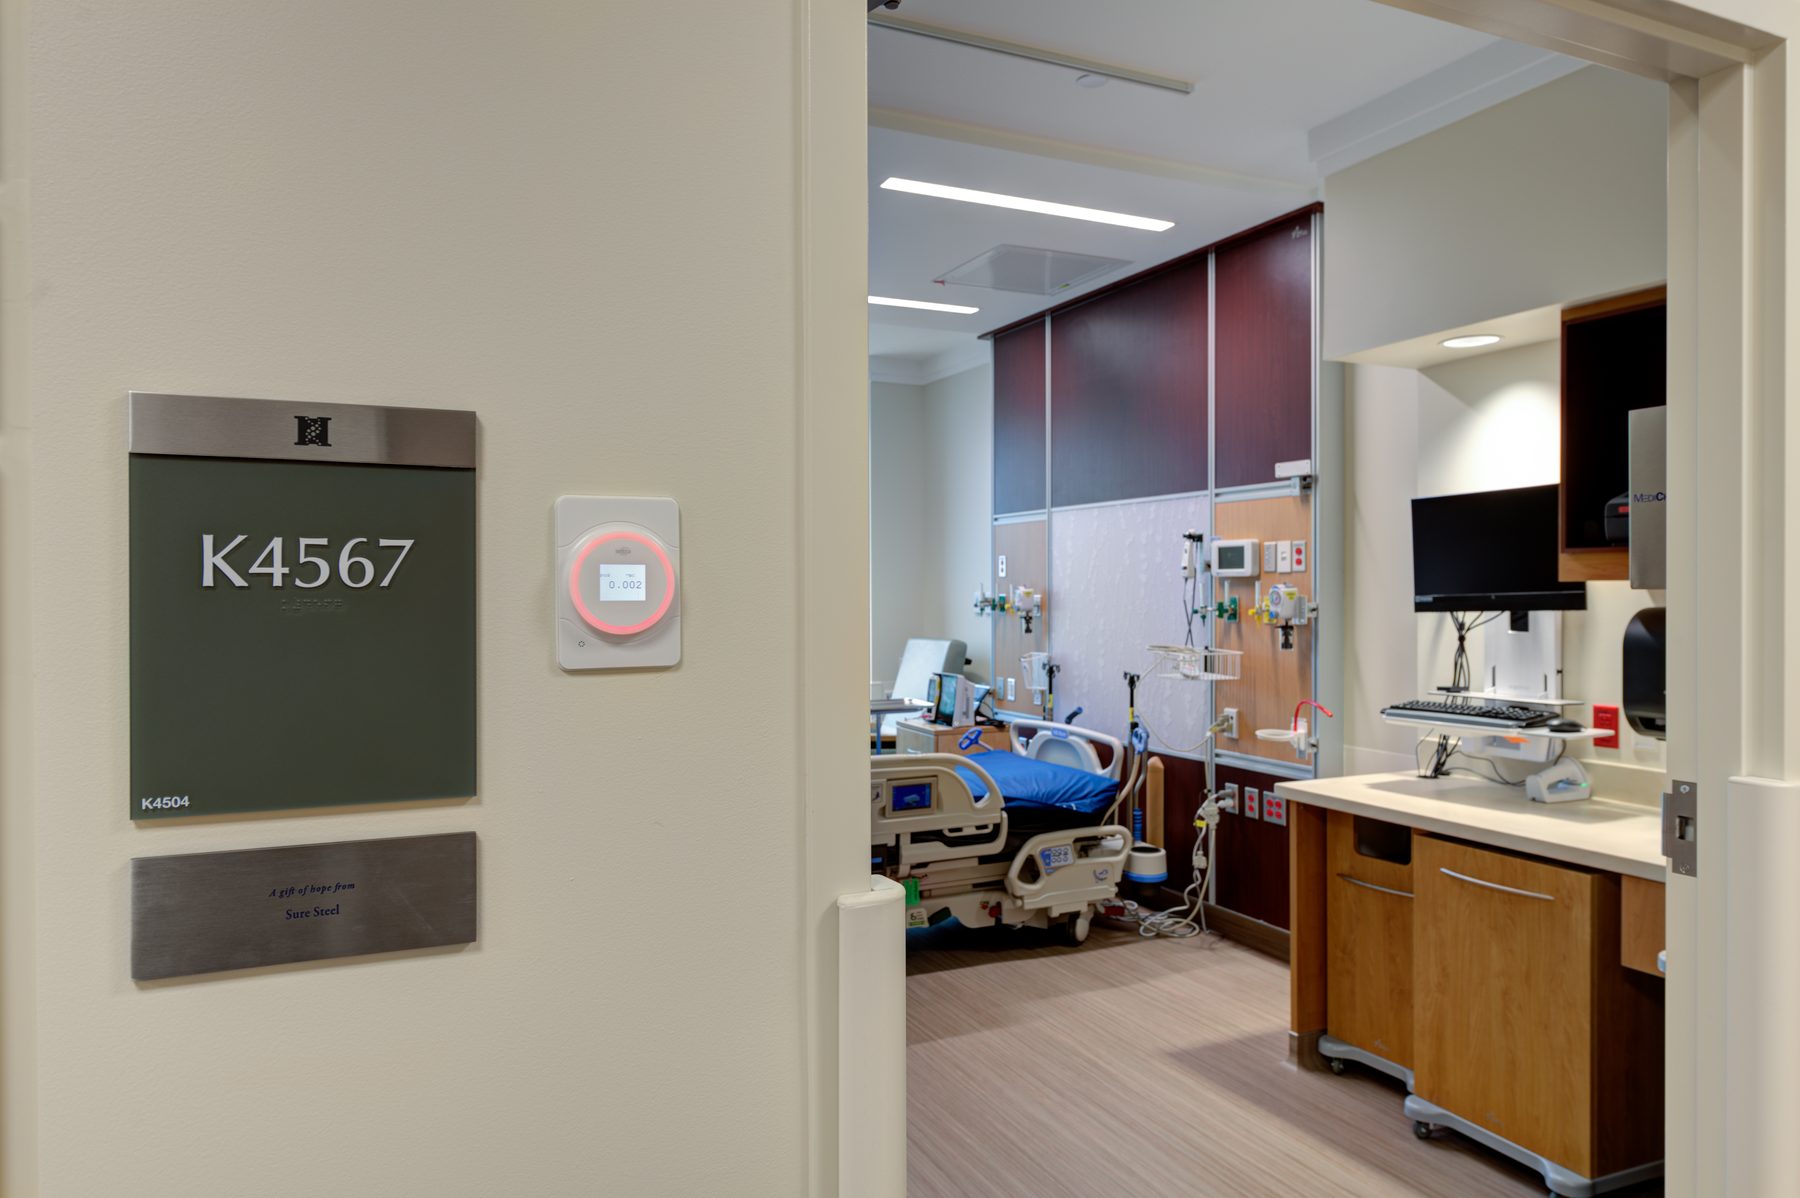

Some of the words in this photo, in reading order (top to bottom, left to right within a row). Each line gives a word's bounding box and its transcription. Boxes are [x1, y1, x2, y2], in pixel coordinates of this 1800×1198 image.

[202, 533, 415, 589] K4567
[608, 580, 642, 590] 0.002
[141, 795, 190, 810] K4504
[268, 888, 276, 898] A
[278, 886, 295, 899] gift
[298, 884, 310, 896] of
[310, 884, 332, 894] hope
[333, 882, 355, 893] from
[286, 908, 311, 920] Sure
[313, 903, 339, 917] Steel
